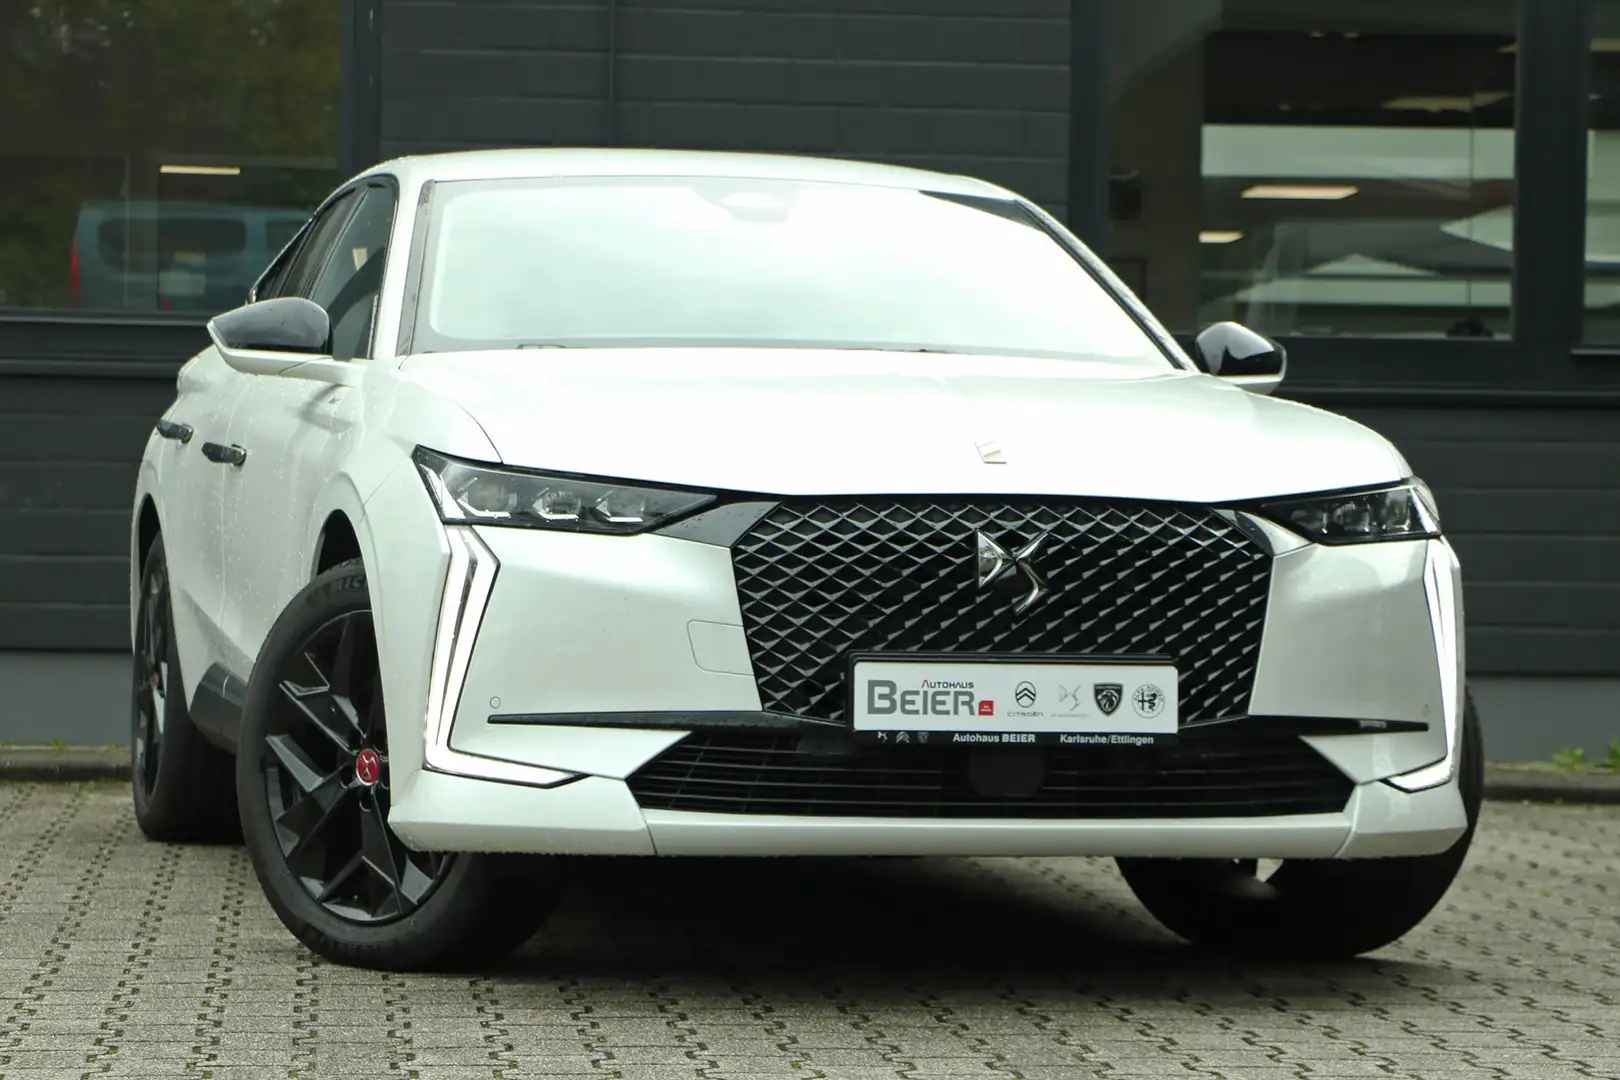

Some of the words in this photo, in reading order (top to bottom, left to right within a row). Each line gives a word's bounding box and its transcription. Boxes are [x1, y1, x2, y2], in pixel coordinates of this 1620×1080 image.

[867, 679, 975, 716] BEIER
[952, 732, 1000, 743] Autohaus
[1002, 733, 1036, 743] BEIER
[1059, 733, 1155, 745] Karlsruhe/Ettlingen
